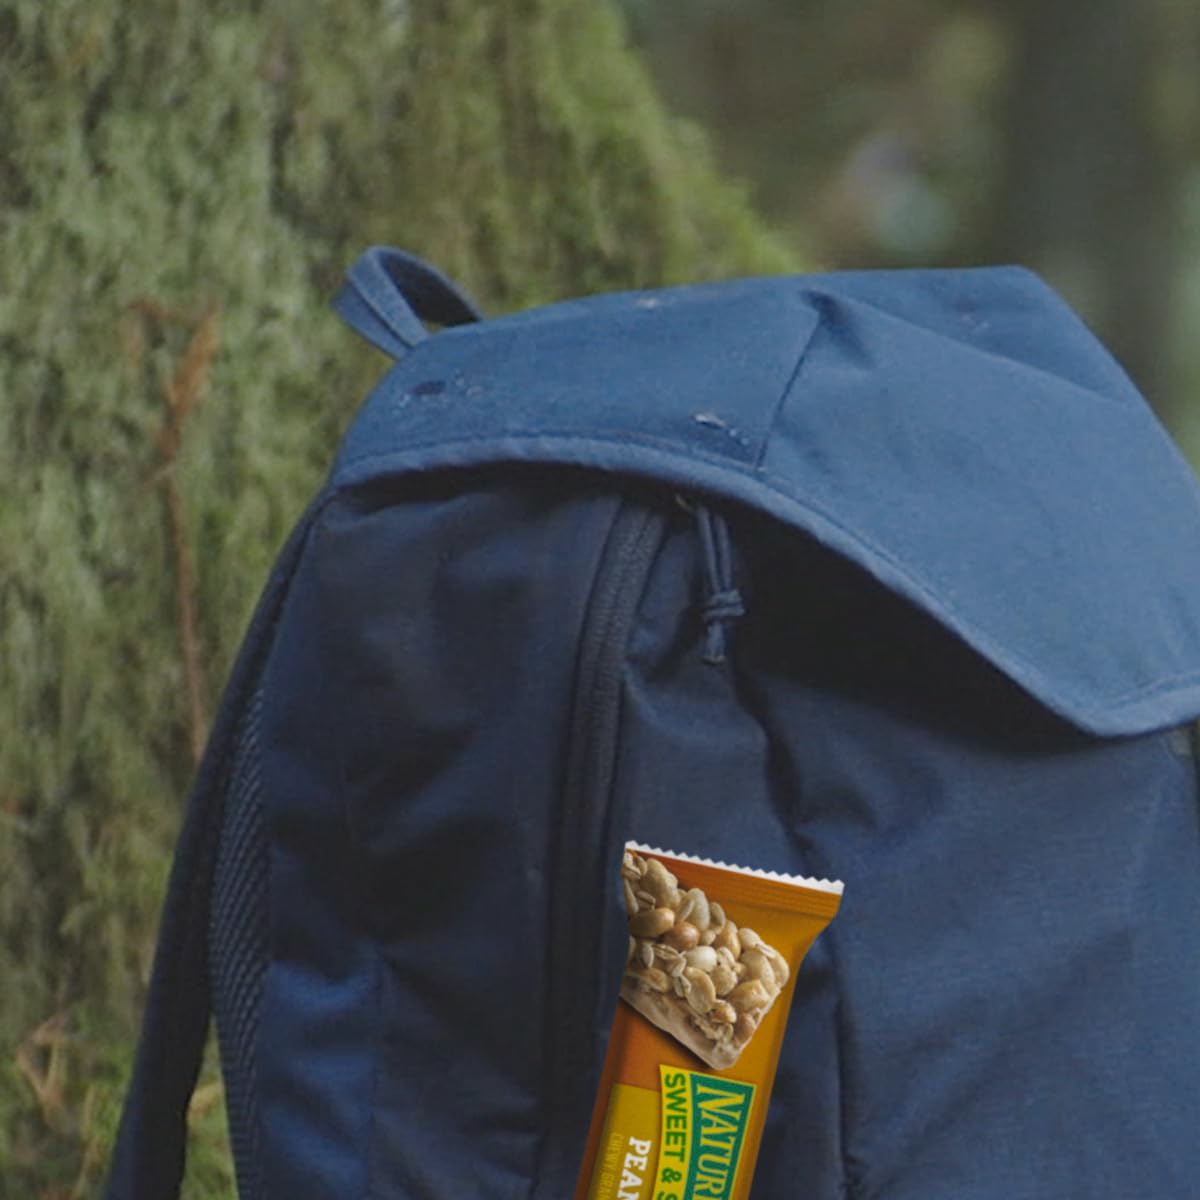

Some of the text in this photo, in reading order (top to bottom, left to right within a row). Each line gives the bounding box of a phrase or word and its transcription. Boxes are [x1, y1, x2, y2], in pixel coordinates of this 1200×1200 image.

[664, 1073, 688, 1163] SWEET
[603, 1131, 625, 1171] CHEWY
[660, 1167, 682, 1184] &
